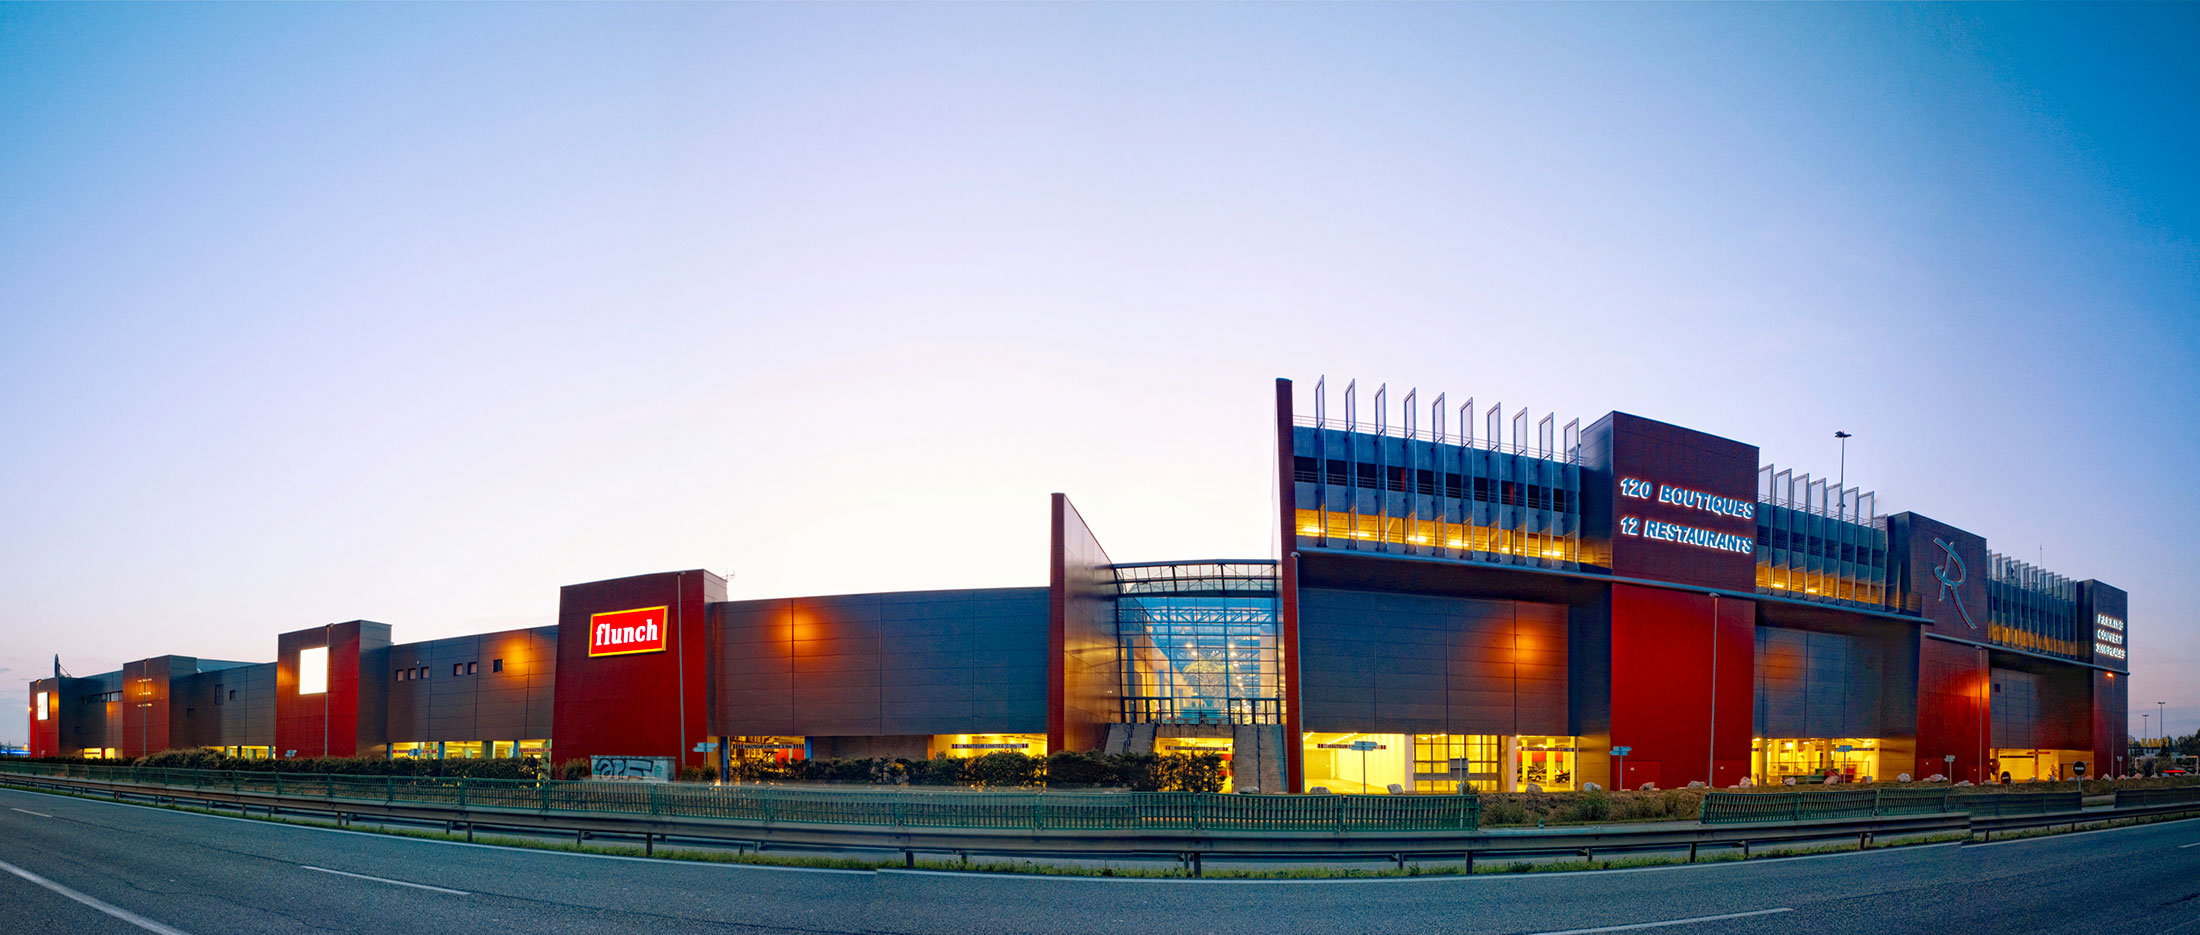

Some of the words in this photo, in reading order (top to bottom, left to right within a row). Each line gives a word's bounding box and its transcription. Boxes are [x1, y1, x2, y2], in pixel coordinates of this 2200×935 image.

[1620, 477, 1653, 499] 120
[1658, 484, 1755, 519] BOUTIQUES
[1620, 516, 1641, 536] 12
[1643, 519, 1753, 554] RESTAURANTS
[595, 618, 658, 646] flunch
[2097, 613, 2124, 631] PARKING
